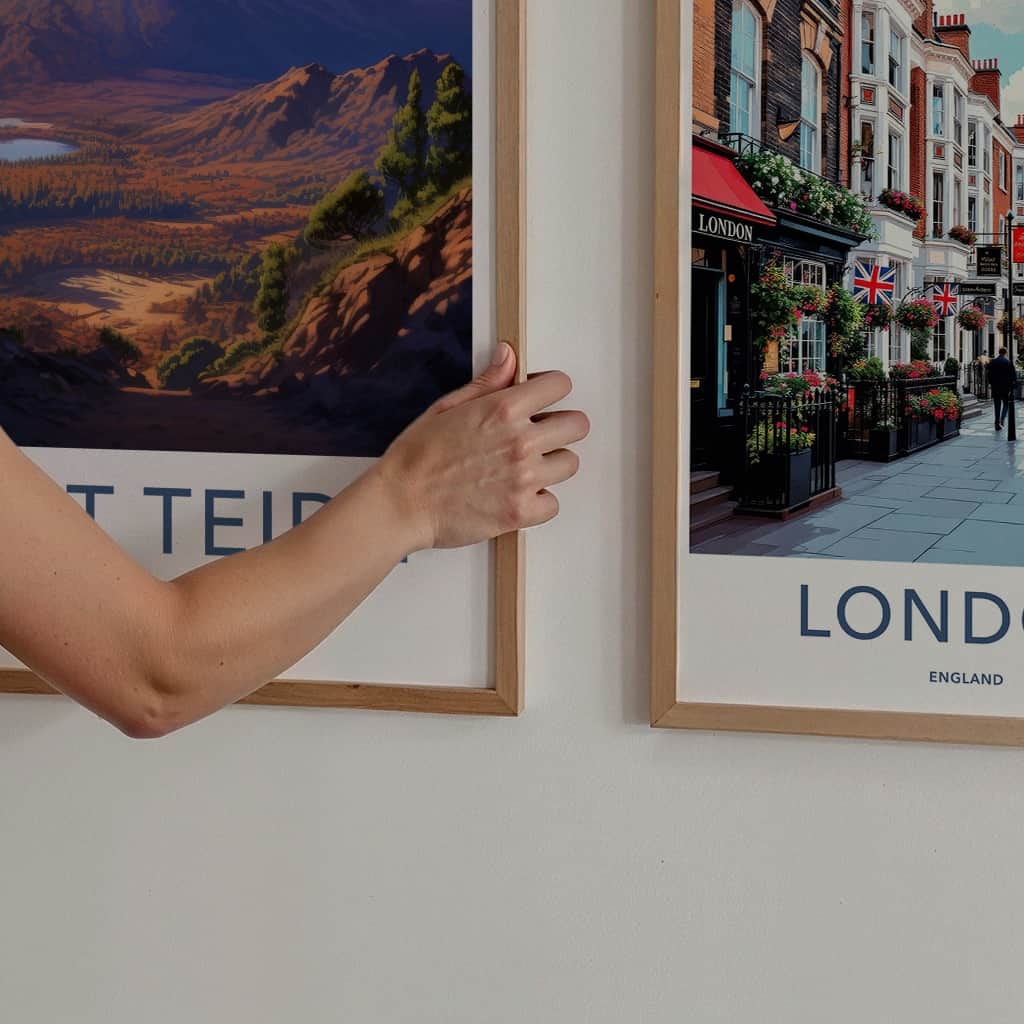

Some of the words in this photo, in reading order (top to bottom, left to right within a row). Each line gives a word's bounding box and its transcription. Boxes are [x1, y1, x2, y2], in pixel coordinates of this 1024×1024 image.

[698, 213, 753, 242] LONDON
[800, 584, 1024, 645] LOND
[929, 671, 1004, 686] ENGLAND
